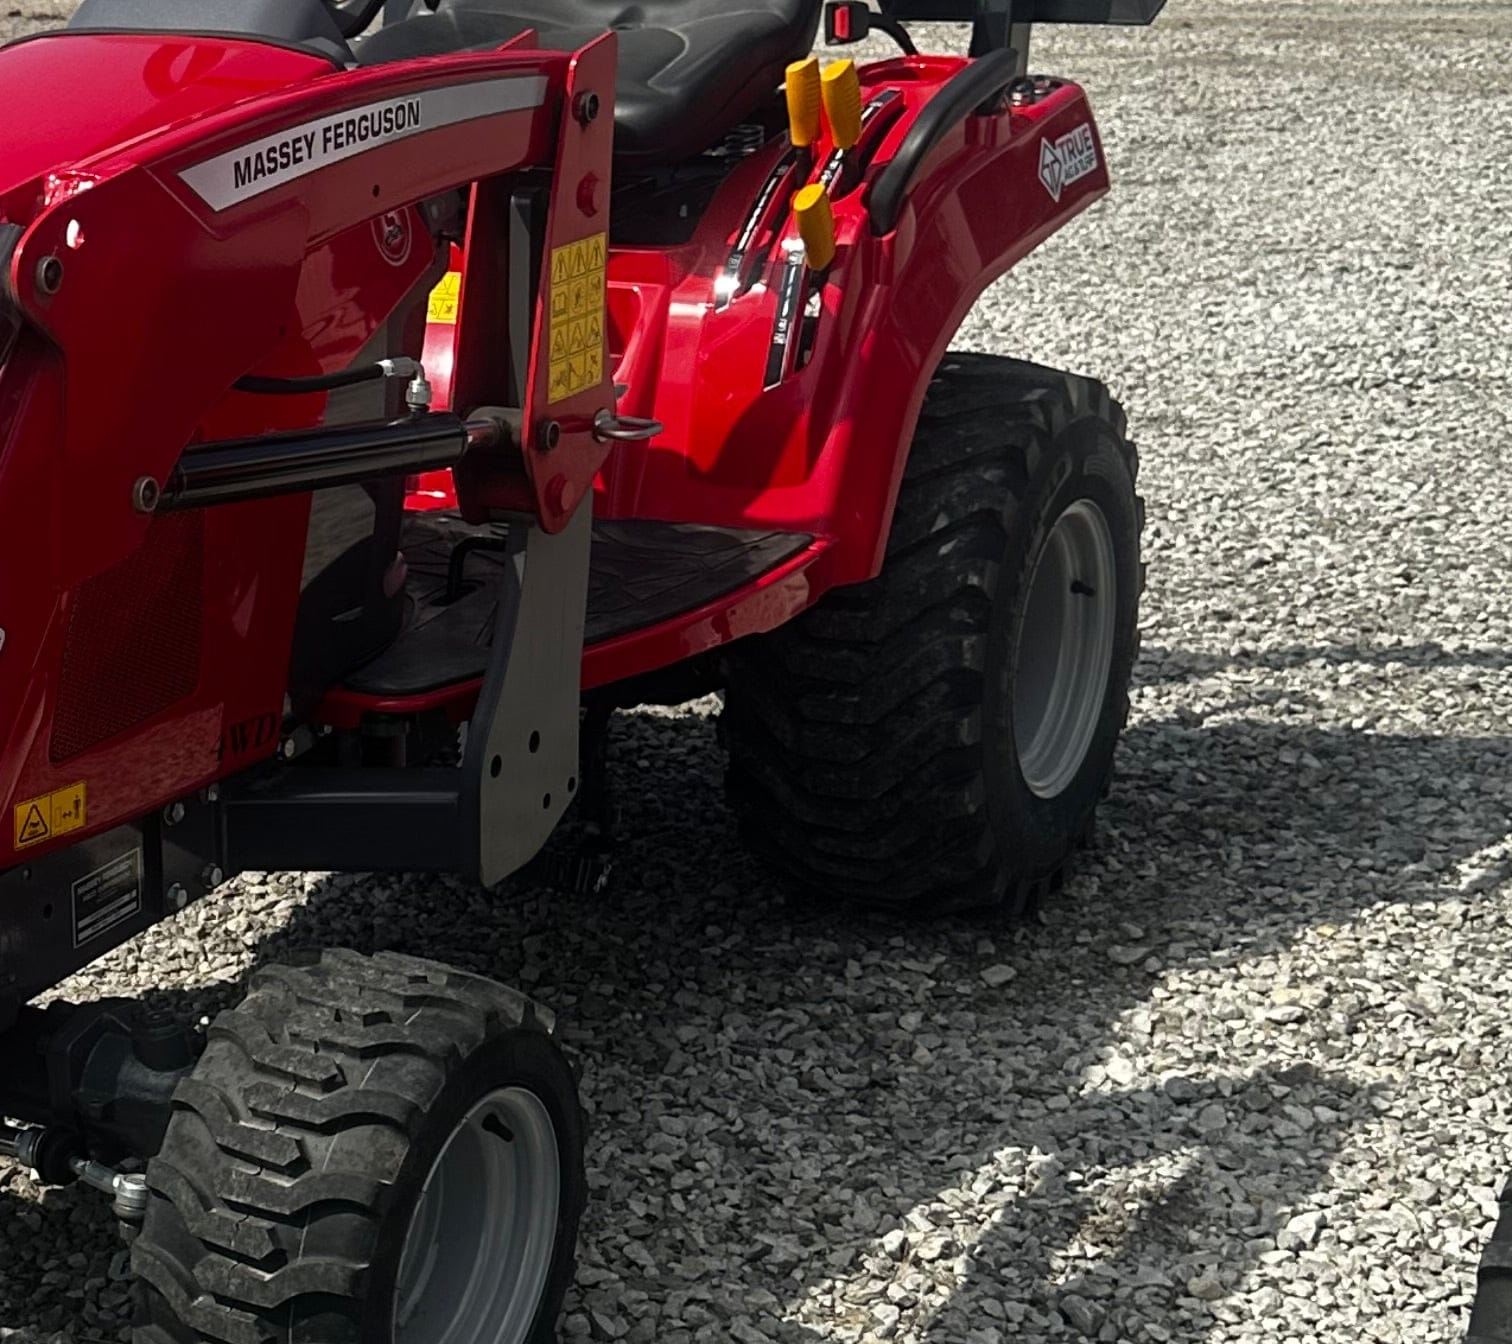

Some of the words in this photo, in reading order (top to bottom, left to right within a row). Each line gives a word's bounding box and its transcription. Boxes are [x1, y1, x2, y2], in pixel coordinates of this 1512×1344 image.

[232, 131, 316, 189] MASSEY
[322, 99, 421, 154] FERGUSON
[1057, 127, 1092, 165] TRUE
